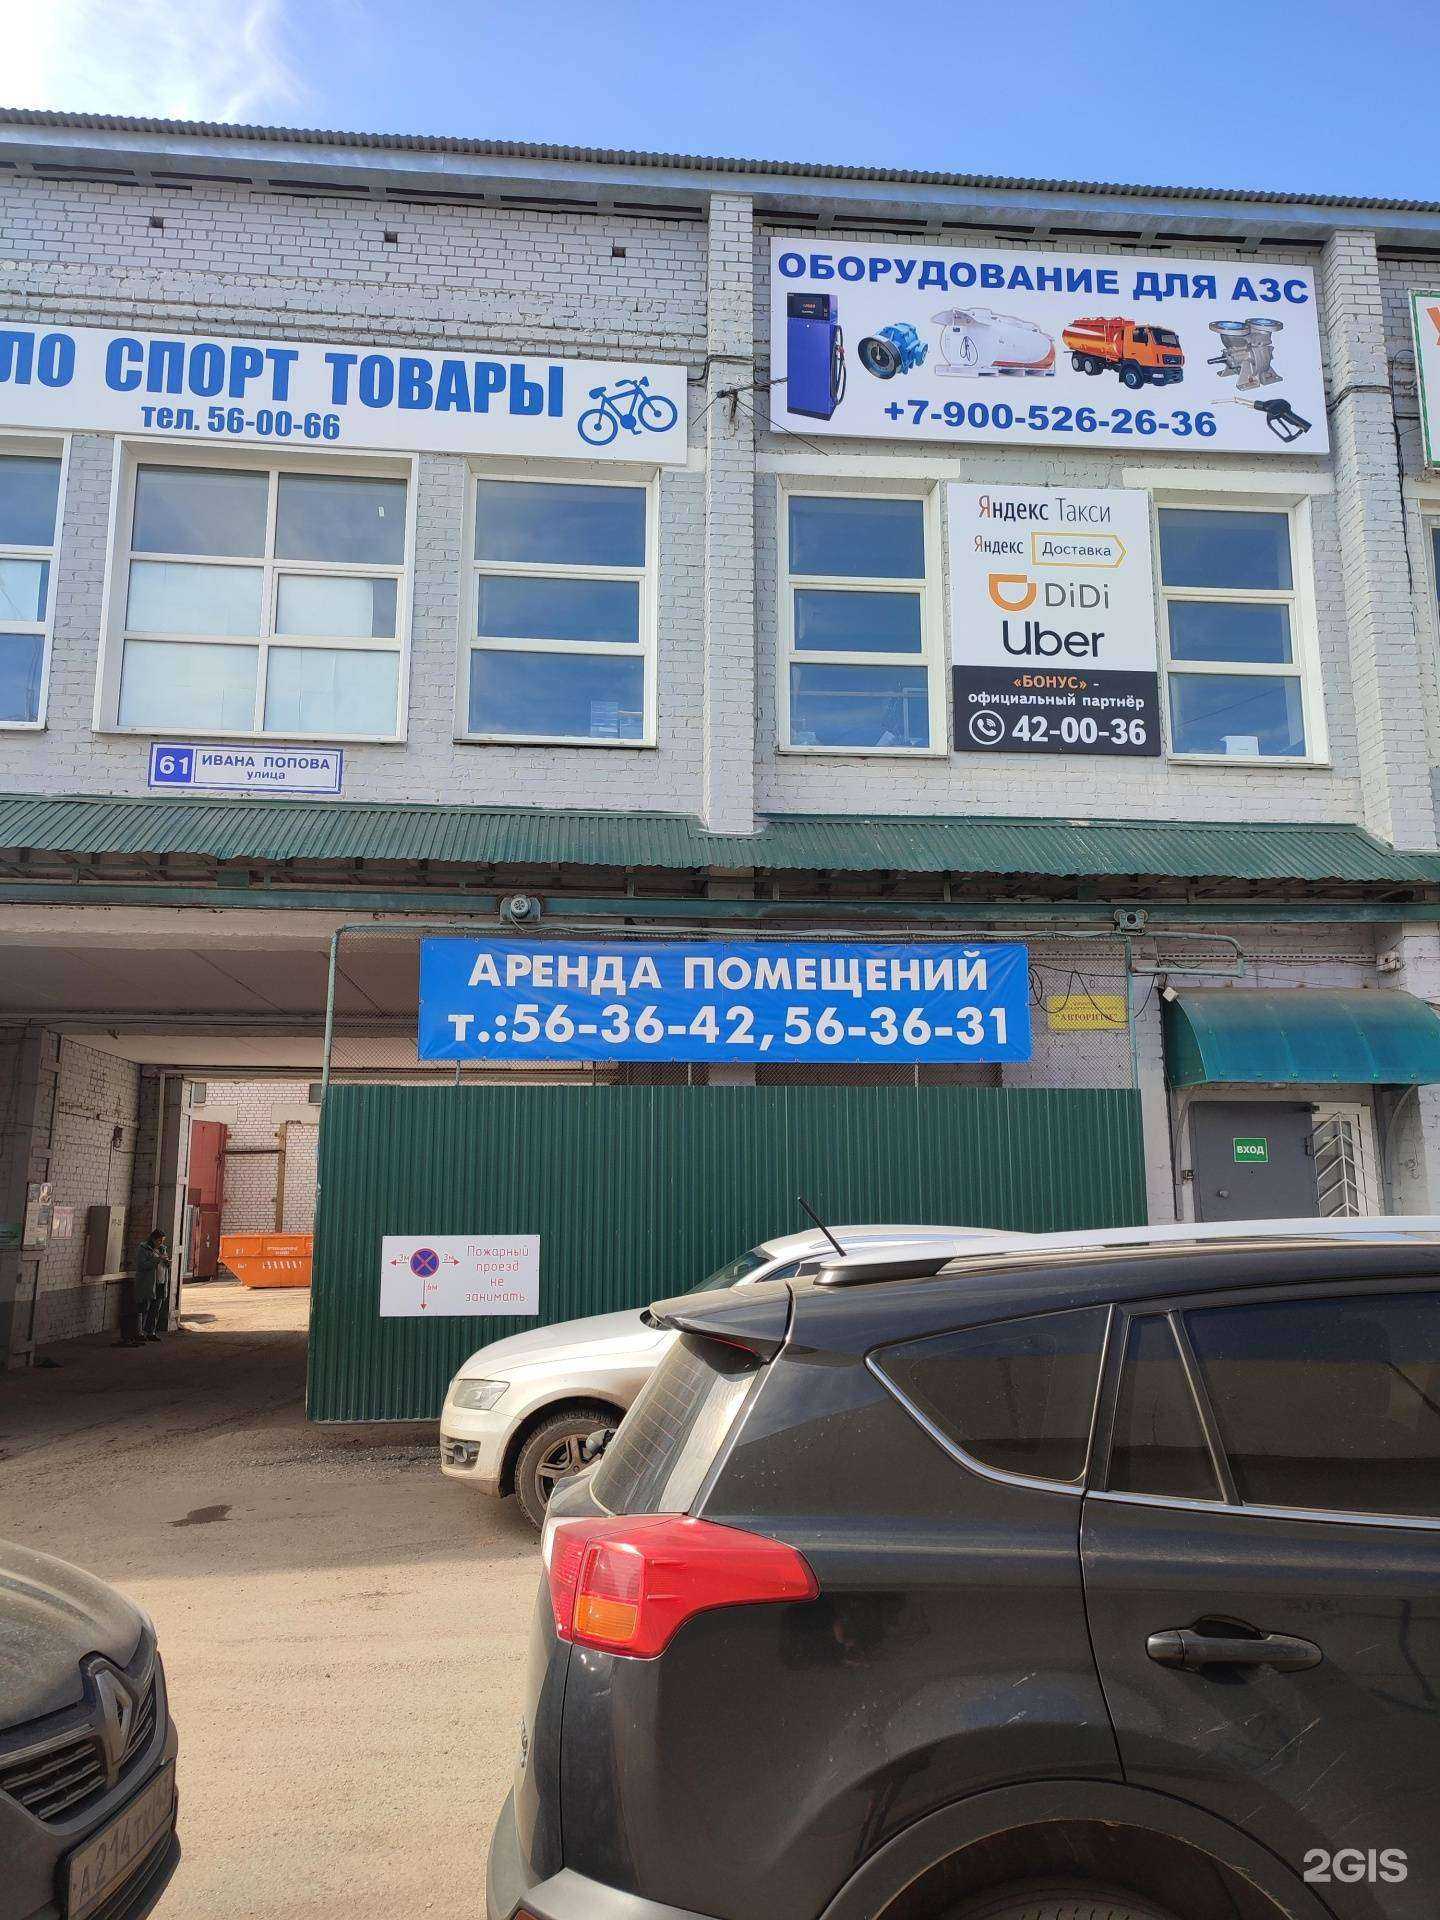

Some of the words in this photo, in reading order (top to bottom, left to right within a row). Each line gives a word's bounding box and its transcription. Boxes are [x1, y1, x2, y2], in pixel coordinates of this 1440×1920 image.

[778, 252, 1120, 295] ОБОРУДОВАНИЕ
[1132, 271, 1217, 301] ДЛЯ
[1231, 277, 1309, 304] АЗС
[105, 337, 299, 402] СПОРТ
[324, 352, 564, 417] ТОВАРЫ
[141, 406, 200, 431] тел.
[207, 406, 341, 440] 56-00-66
[884, 399, 1217, 437] +7-900-526-26-36
[978, 495, 1049, 522] Яндекс
[1055, 497, 1111, 523] Такси
[974, 535, 1024, 556] Яндекс
[1042, 541, 1111, 557] Доставка
[1044, 582, 1109, 609] DiDi
[1002, 620, 1105, 657] Uber
[968, 691, 1076, 706] официальный
[1082, 694, 1145, 710] партнёр
[1011, 714, 1147, 745] 42-00-36
[159, 755, 189, 775] 61
[201, 754, 256, 767] ИВАНА
[263, 756, 330, 770] ПОПОВА
[246, 770, 286, 780] улица
[468, 953, 662, 996] АРЕНДА
[684, 950, 987, 998] ПОМЕЩЕНИЙ
[1236, 1145, 1265, 1156] ВХОД
[466, 1245, 529, 1258] Пожарный
[476, 1259, 520, 1274] проезд
[490, 1277, 504, 1287] не
